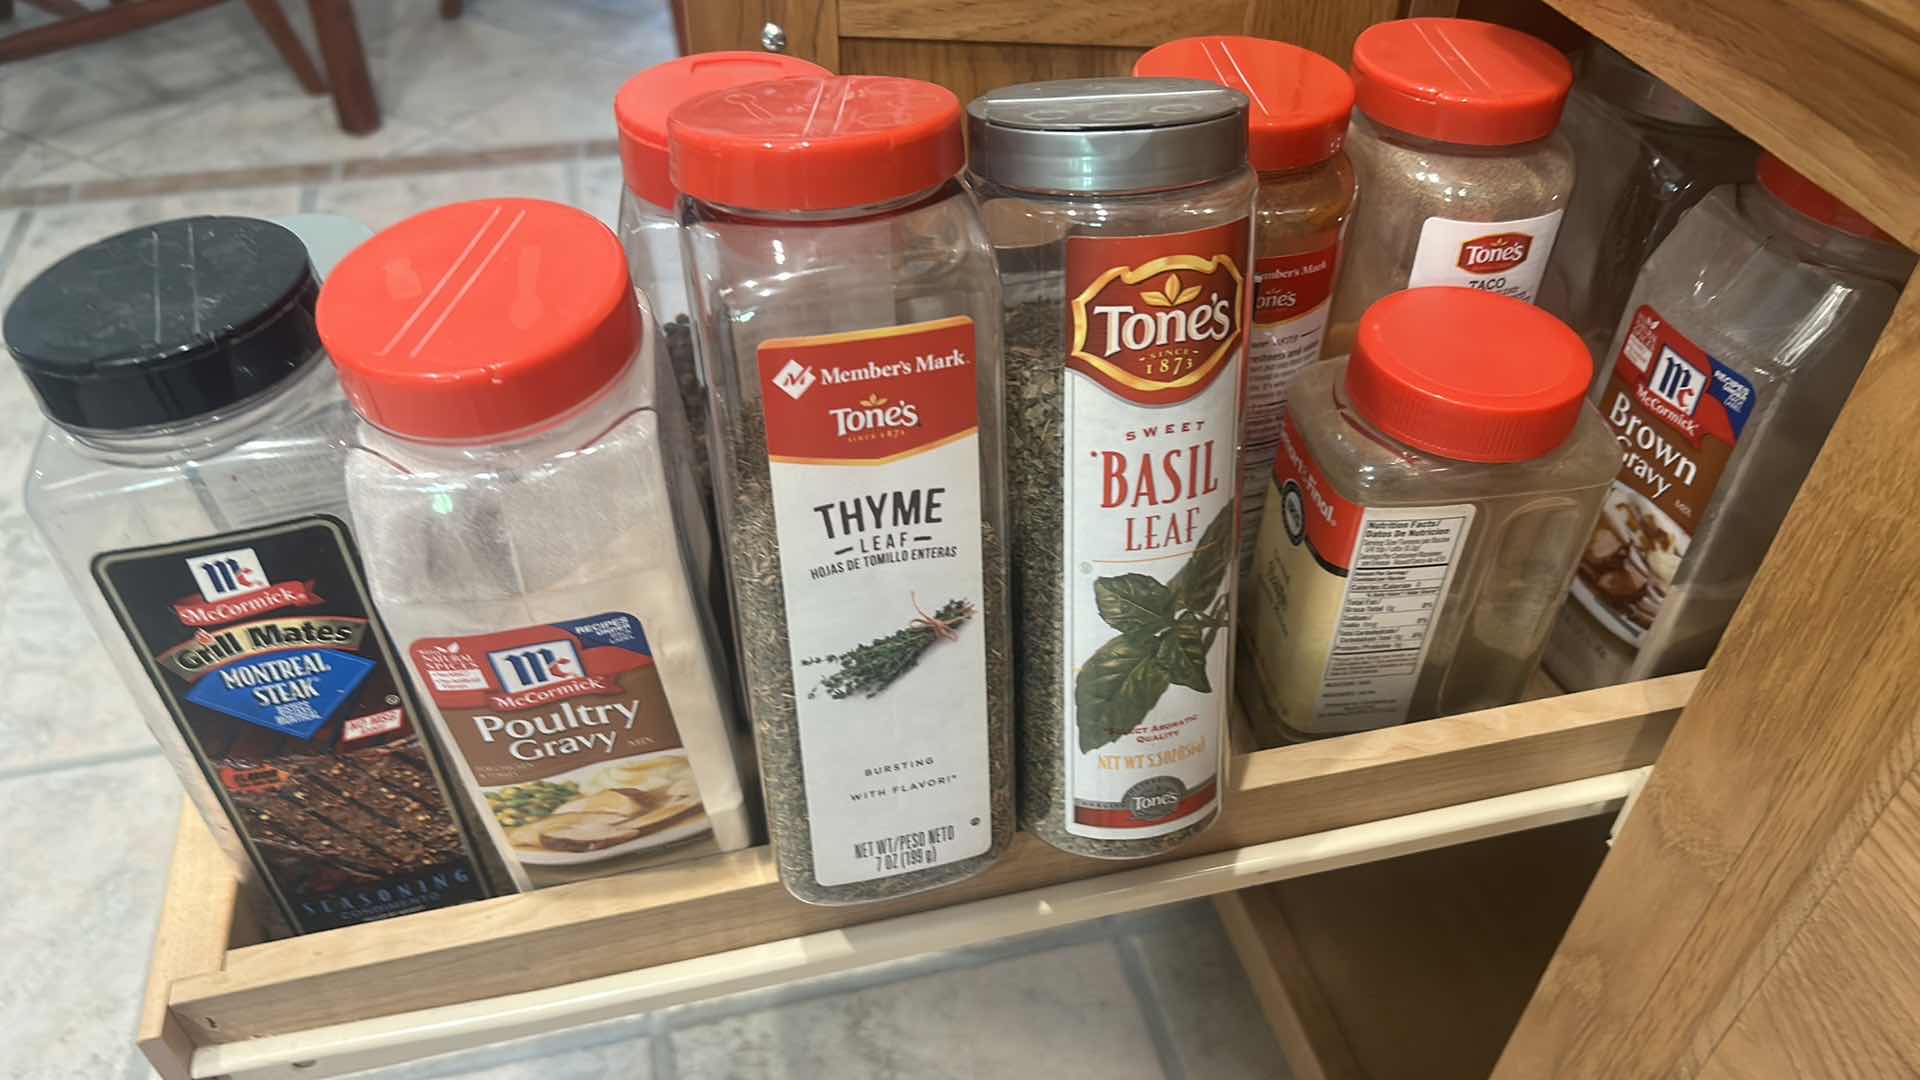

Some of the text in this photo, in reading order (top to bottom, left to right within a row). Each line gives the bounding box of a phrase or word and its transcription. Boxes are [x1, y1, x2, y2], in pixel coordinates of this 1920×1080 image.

[1465, 242, 1524, 266] Tone's
[1257, 290, 1297, 309] one's
[1468, 277, 1506, 290] TACO
[1093, 292, 1230, 358] Tone's
[820, 349, 965, 386] Member's Mark
[1146, 357, 1193, 376] 1873
[829, 400, 920, 437] Tone's
[1636, 384, 1699, 437] McCormick
[1125, 421, 1205, 441] SWEET
[1609, 392, 1698, 487] Brown
[1100, 440, 1218, 509] BASIL
[813, 487, 946, 540] THYME
[1124, 507, 1200, 551] LEAF
[859, 532, 908, 554] LEAF
[810, 545, 958, 580] HOJAS DE TOMILLO ENTERAS
[181, 587, 297, 624] McCormick
[177, 621, 353, 672] Grill Mates
[219, 652, 332, 691] MONTREAL
[251, 678, 321, 708] STEAK
[493, 676, 605, 709] McCormick
[472, 700, 640, 743] Poultry
[1136, 731, 1180, 744] QUALITY
[509, 731, 617, 761] Gravy
[1098, 755, 1121, 770] NET
[1123, 754, 1144, 768] WT
[864, 757, 935, 777] BURSTING
[850, 789, 886, 801] WITH
[1131, 792, 1178, 810] Tone's
[854, 825, 954, 858] NET WT/PESO NETO
[875, 856, 882, 872] 7
[884, 853, 898, 870] OZ
[303, 868, 470, 914] SEASONING
